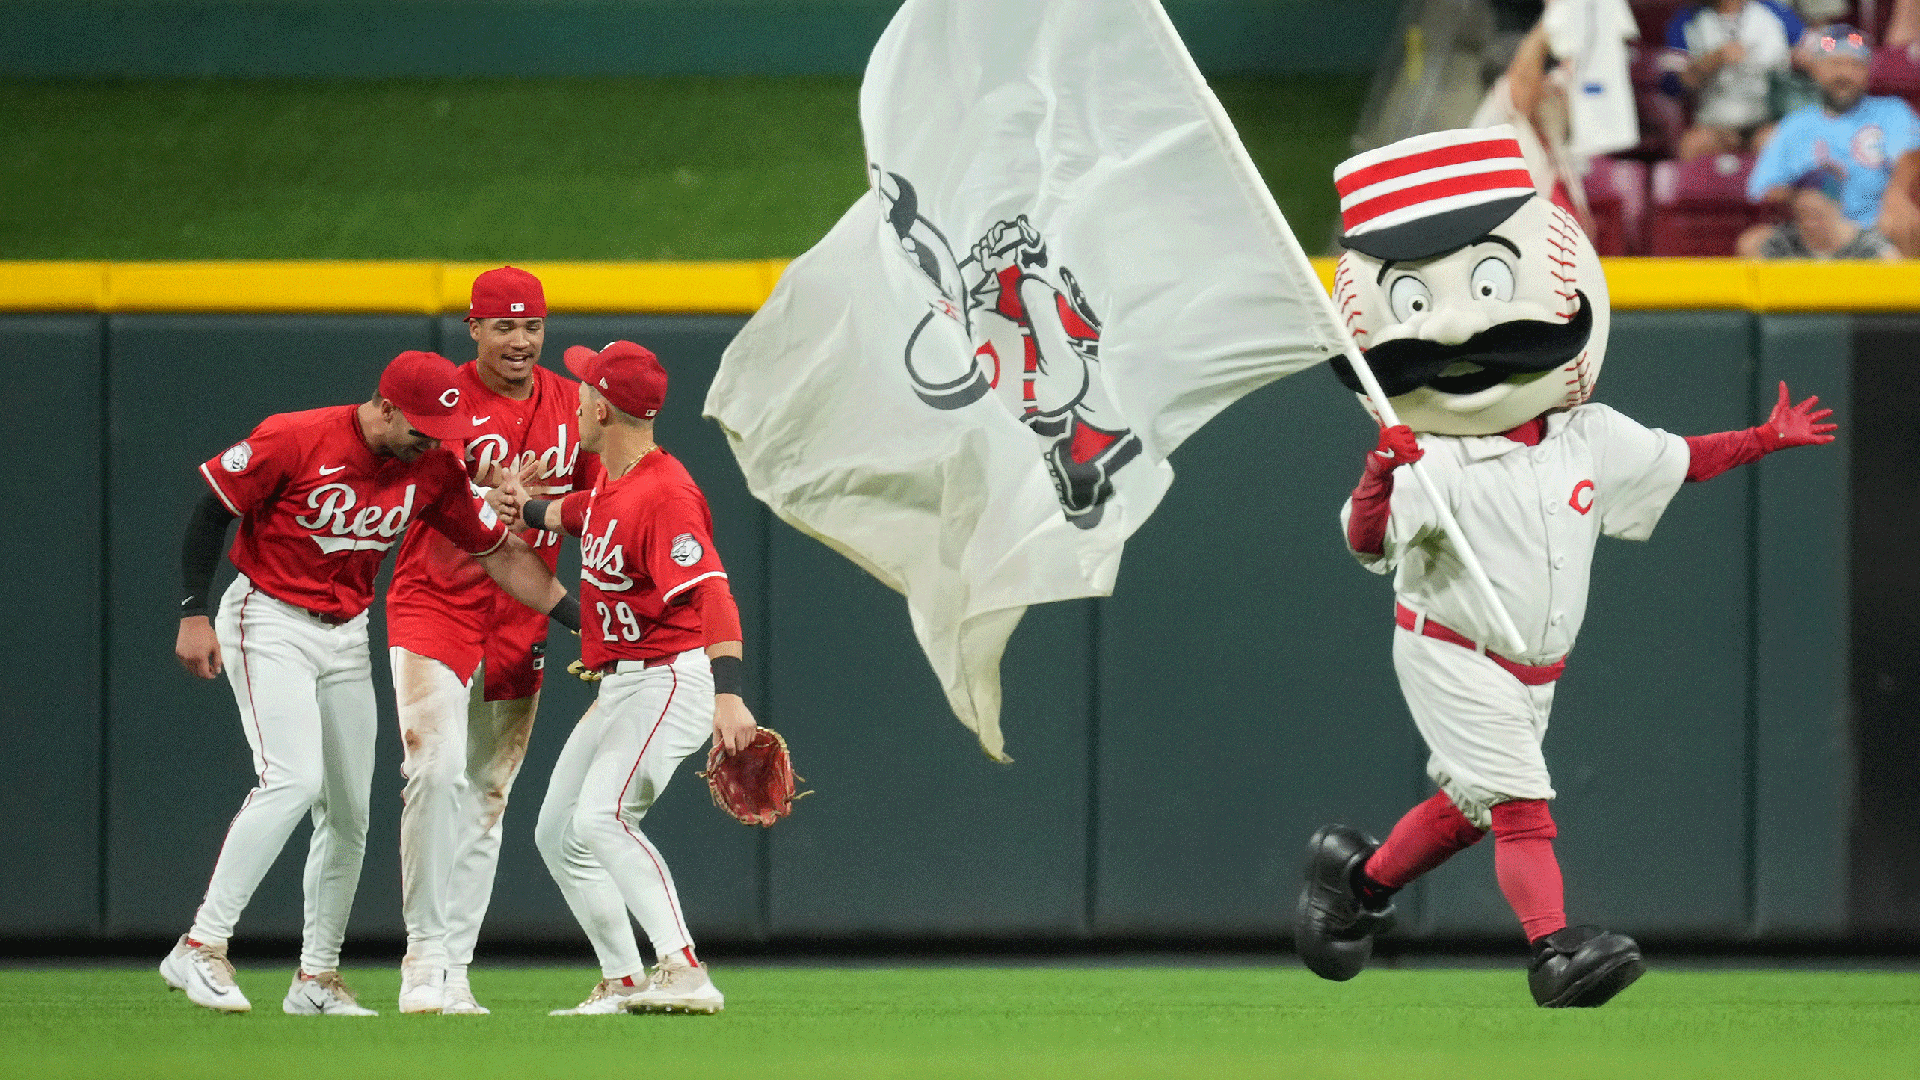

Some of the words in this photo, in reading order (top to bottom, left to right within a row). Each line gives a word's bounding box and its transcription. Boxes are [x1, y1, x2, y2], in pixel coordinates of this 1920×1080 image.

[439, 388, 460, 408] C
[1569, 479, 1595, 516] C
[596, 601, 641, 641] 29
